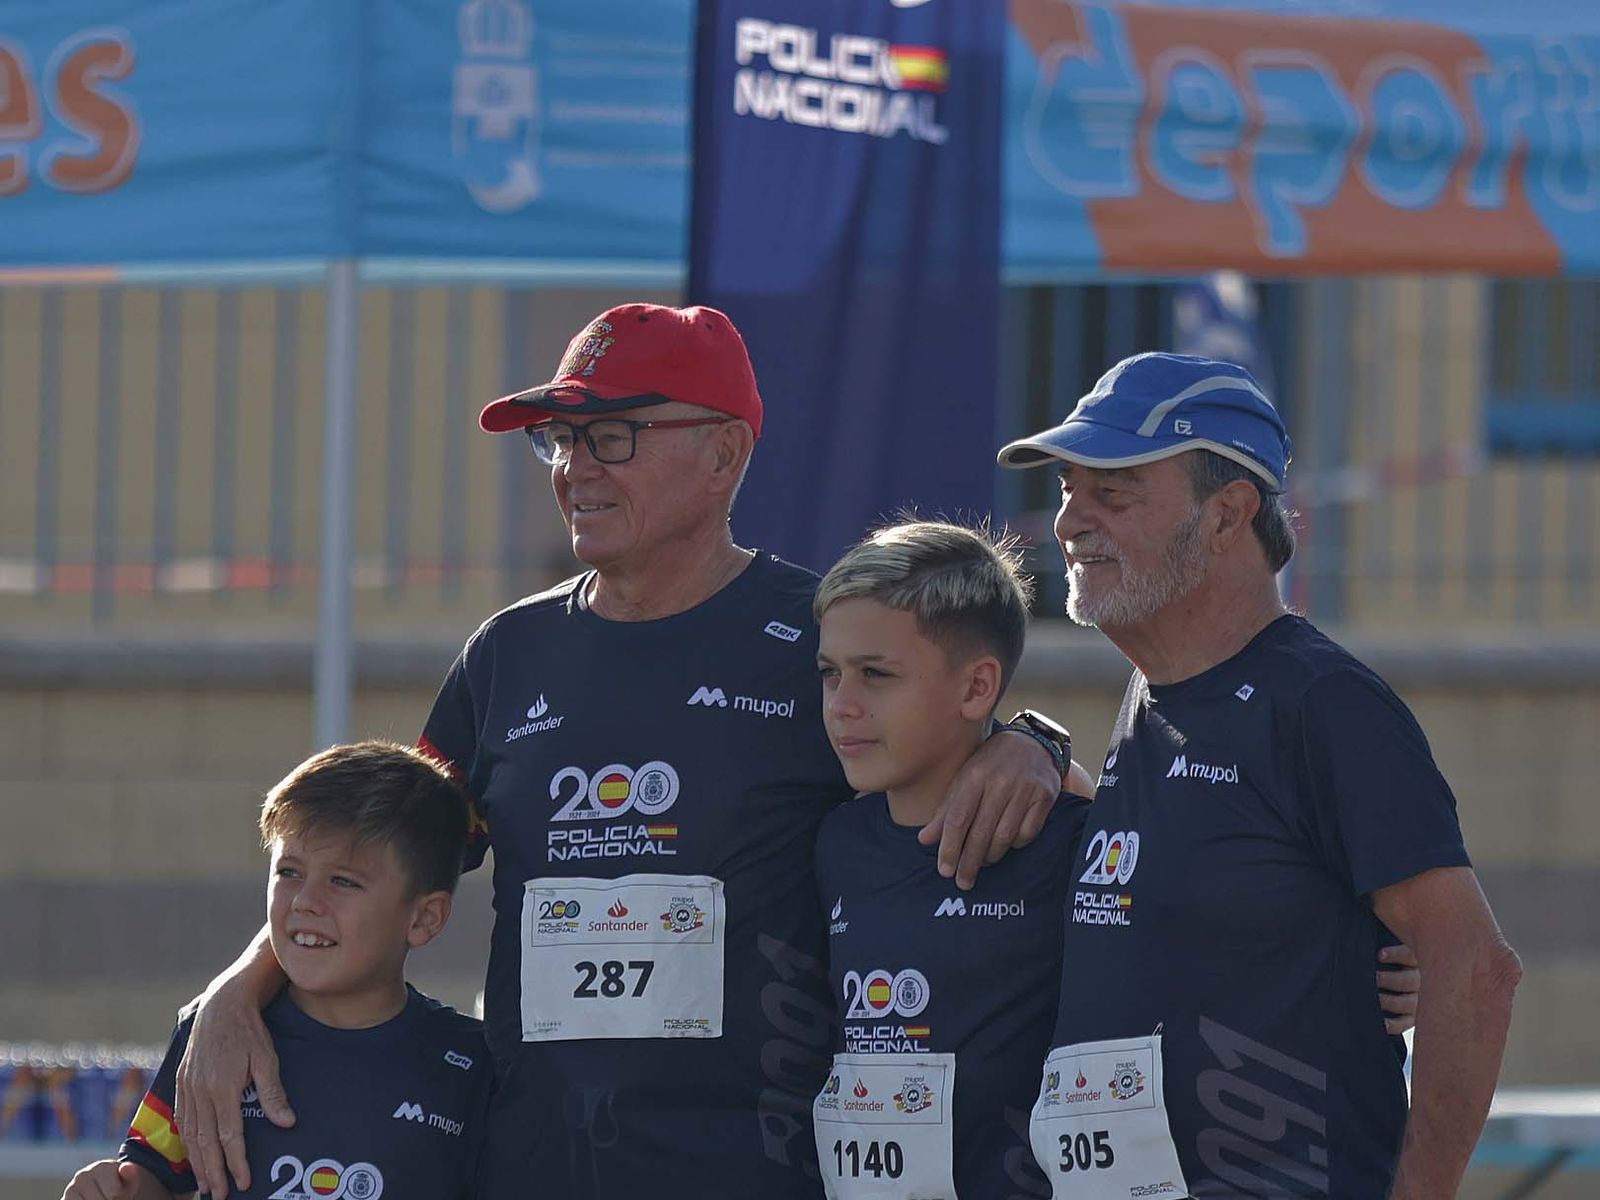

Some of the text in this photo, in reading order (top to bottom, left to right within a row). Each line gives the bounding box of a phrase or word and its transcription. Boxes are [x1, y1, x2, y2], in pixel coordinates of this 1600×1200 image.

[733, 695, 795, 718] mupol
[505, 715, 565, 743] Santander
[1190, 763, 1239, 785] mupol
[549, 760, 680, 822] 200
[548, 825, 650, 845] POLICIA
[548, 840, 676, 862] NACIONAL
[1079, 829, 1140, 886] 200
[539, 900, 581, 920] 200
[971, 900, 1025, 920] mupol
[1074, 891, 1120, 909] POLICIA
[587, 920, 649, 932] Santander
[1072, 908, 1131, 926] NACIONAL
[573, 960, 655, 998] 287
[843, 968, 931, 1019] 200
[844, 1025, 907, 1039] POLICIA
[845, 1039, 931, 1053] NACIONAL
[844, 1099, 885, 1112] Santander
[1065, 1091, 1102, 1104] Santander
[428, 1112, 465, 1136] mupol
[833, 1139, 904, 1179] 1140
[1058, 1130, 1115, 1173] 305
